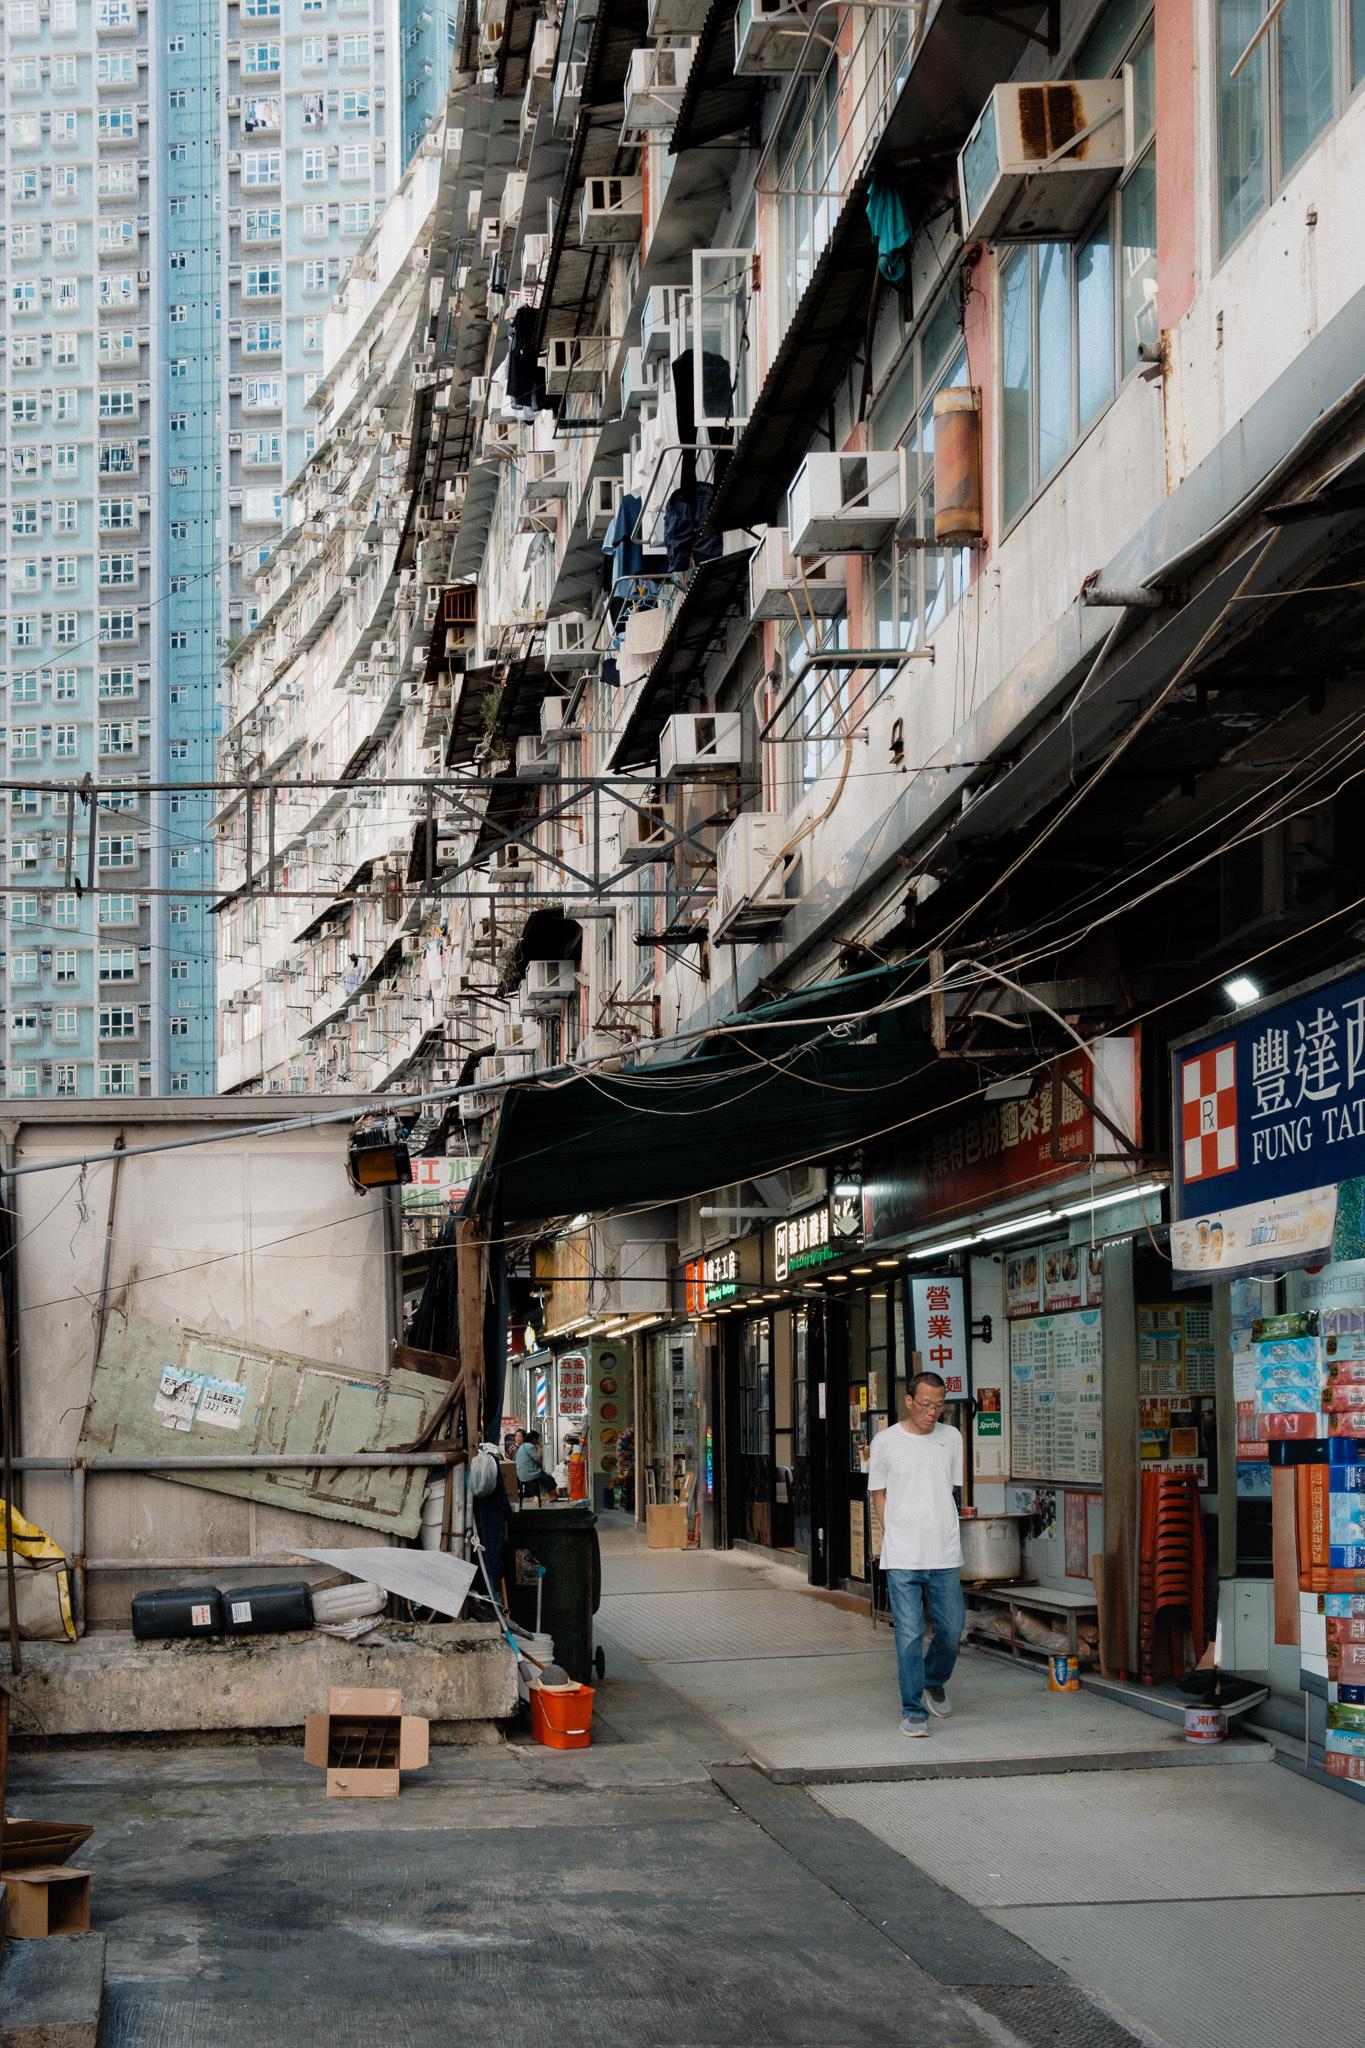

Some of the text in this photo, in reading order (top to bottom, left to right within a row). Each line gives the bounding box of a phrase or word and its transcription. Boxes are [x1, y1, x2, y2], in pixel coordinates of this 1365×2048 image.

[1252, 1116, 1313, 1165] FUNG
[926, 1285, 953, 1368] 營業中
[560, 1357, 585, 1369] 五金
[560, 1373, 585, 1385] 漆油
[946, 1376, 963, 1393] 麵
[560, 1387, 585, 1399] 水喉
[560, 1402, 585, 1415] 配件
[978, 1421, 1001, 1430] Sprite
